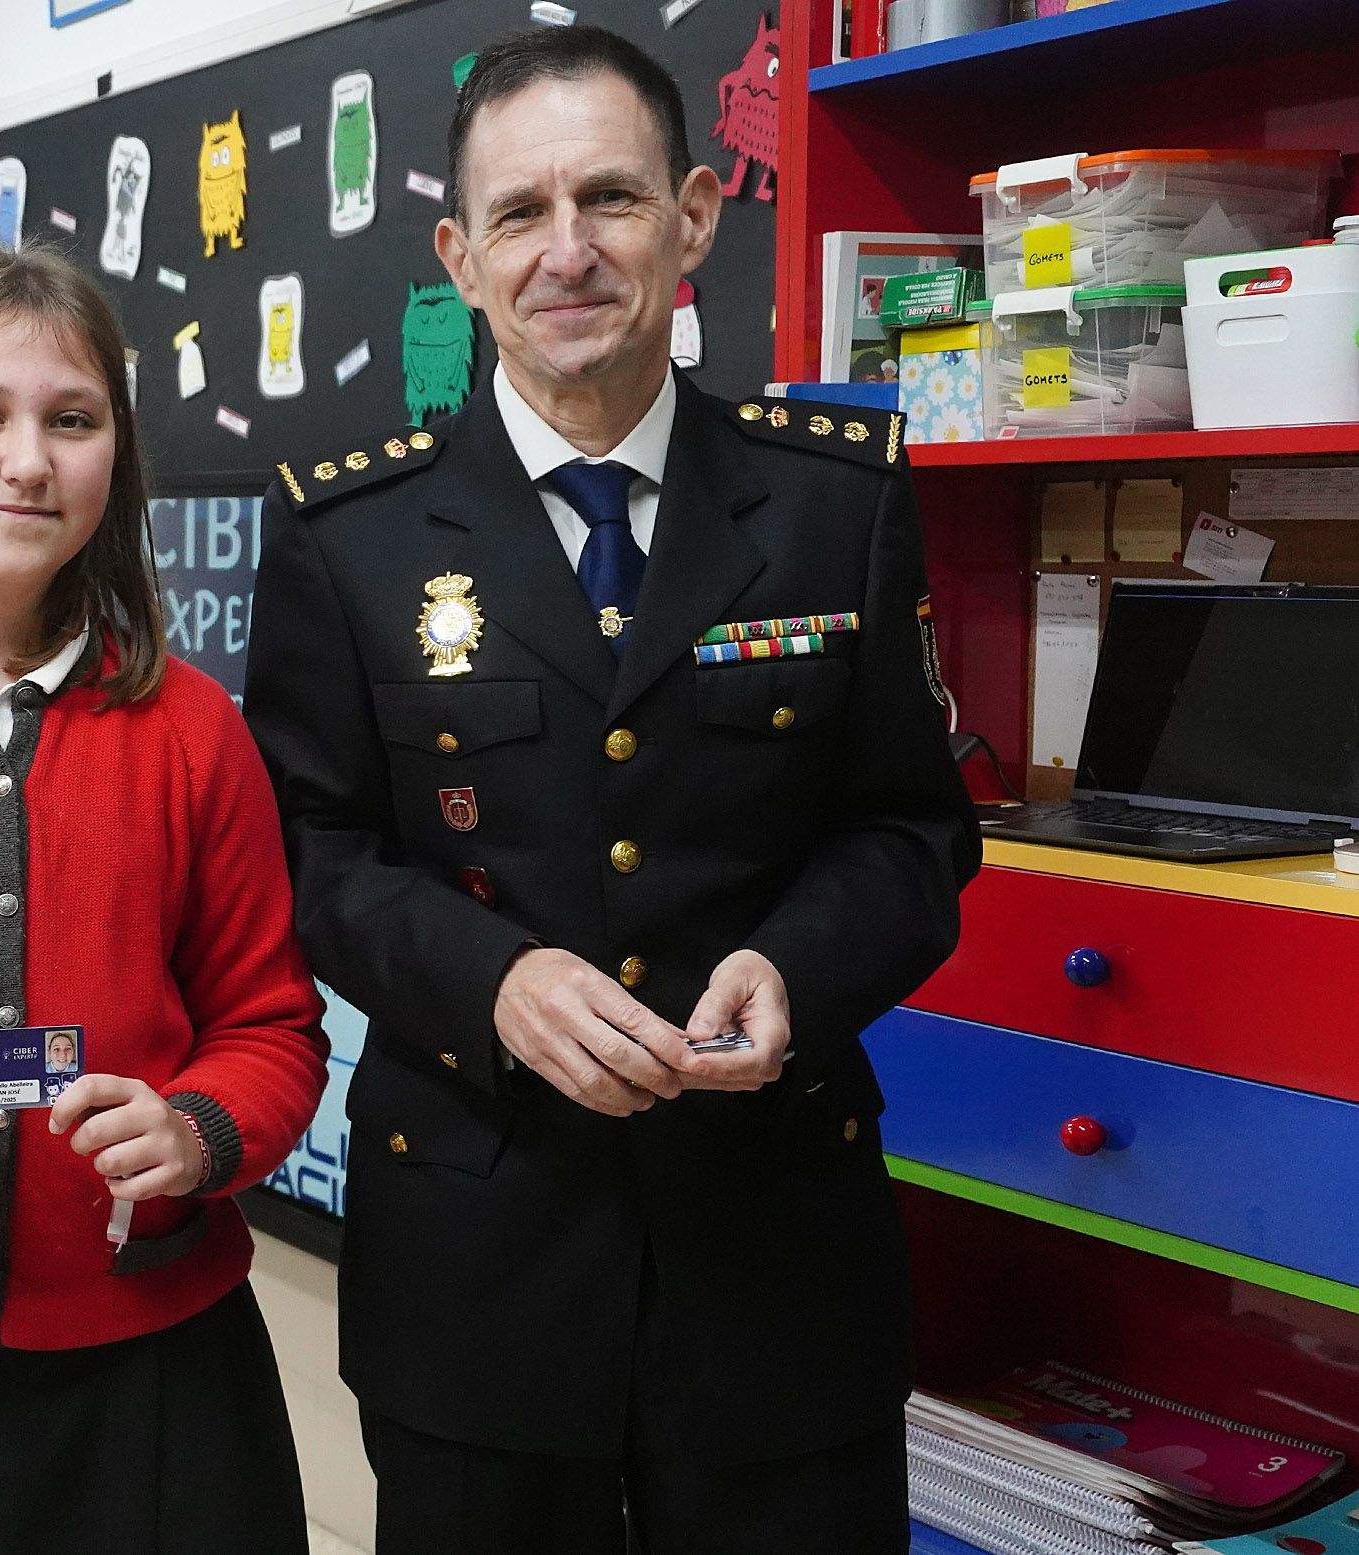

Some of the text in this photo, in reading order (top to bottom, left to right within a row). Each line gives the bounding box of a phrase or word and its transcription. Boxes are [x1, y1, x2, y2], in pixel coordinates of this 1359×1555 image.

[1025, 373, 1068, 387] GOMETS
[142, 497, 263, 569] CIB
[166, 588, 254, 653] XPE
[13, 1046, 38, 1055] CIBER
[1258, 1455, 1288, 1473] 3
